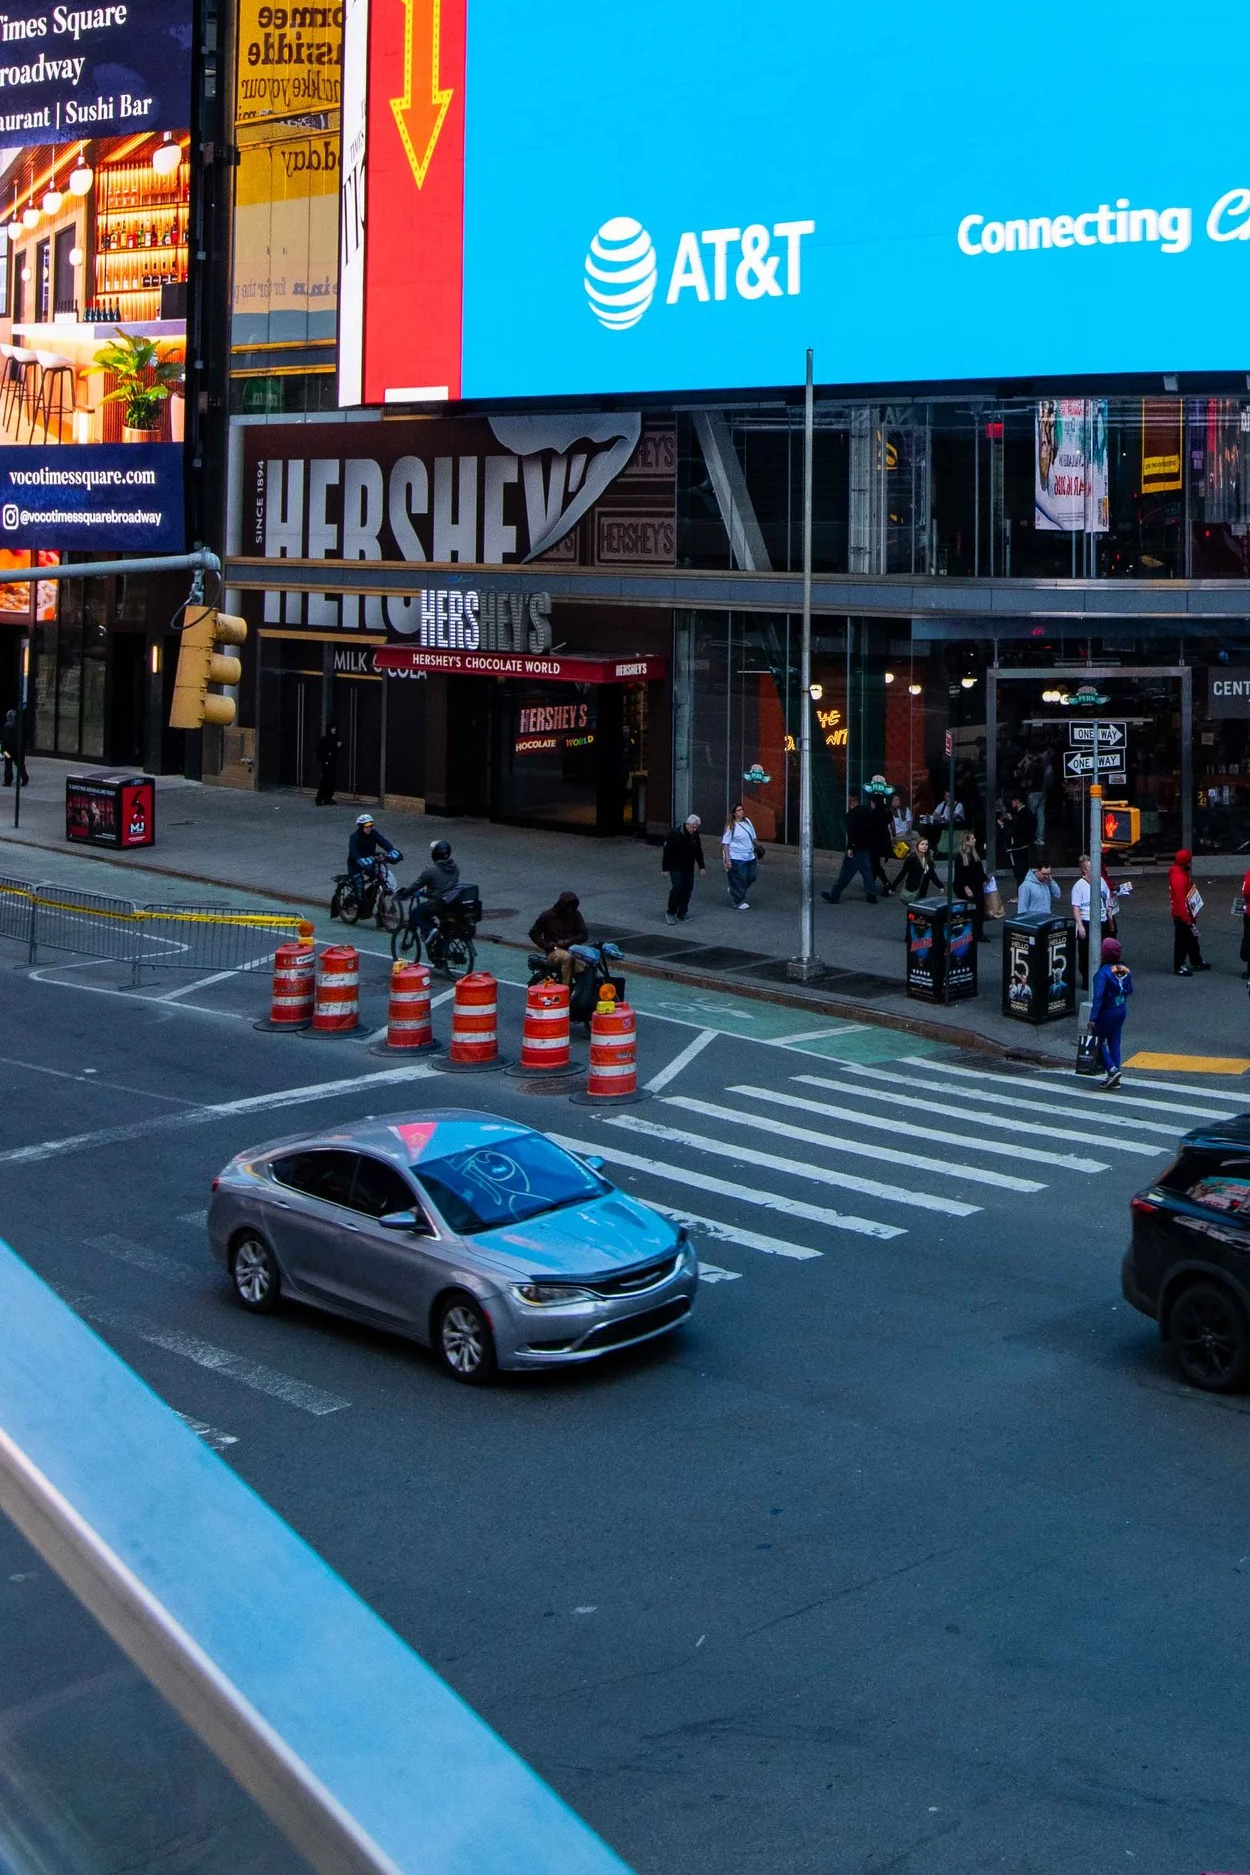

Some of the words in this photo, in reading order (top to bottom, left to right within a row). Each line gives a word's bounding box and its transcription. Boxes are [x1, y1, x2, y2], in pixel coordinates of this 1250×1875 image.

[51, 3, 129, 42] Square
[64, 98, 115, 127] Sushi
[120, 94, 153, 120] Bar
[956, 198, 1193, 256] Connecting
[665, 219, 815, 304] AT&T
[9, 465, 156, 492] vocotimessquare.com
[254, 458, 265, 493] 1894
[19, 508, 162, 528] @vocotimessquarebroadway
[254, 496, 265, 545] SINCE
[263, 451, 592, 634] HERSHEY'
[420, 588, 552, 655] HERSHEY'S
[333, 649, 368, 673] MILK
[412, 653, 462, 668] HERSHEY'S
[465, 657, 523, 673] CHOCOLATE
[525, 660, 561, 675] WORLD
[615, 662, 648, 677] HERSHEY'S
[566, 735, 594, 748] WORLD
[1078, 729, 1094, 739] ONE
[1100, 730, 1118, 740] WAY
[1073, 758, 1090, 769] ONE
[1097, 756, 1117, 766] WAY
[130, 821, 145, 833] MJ
